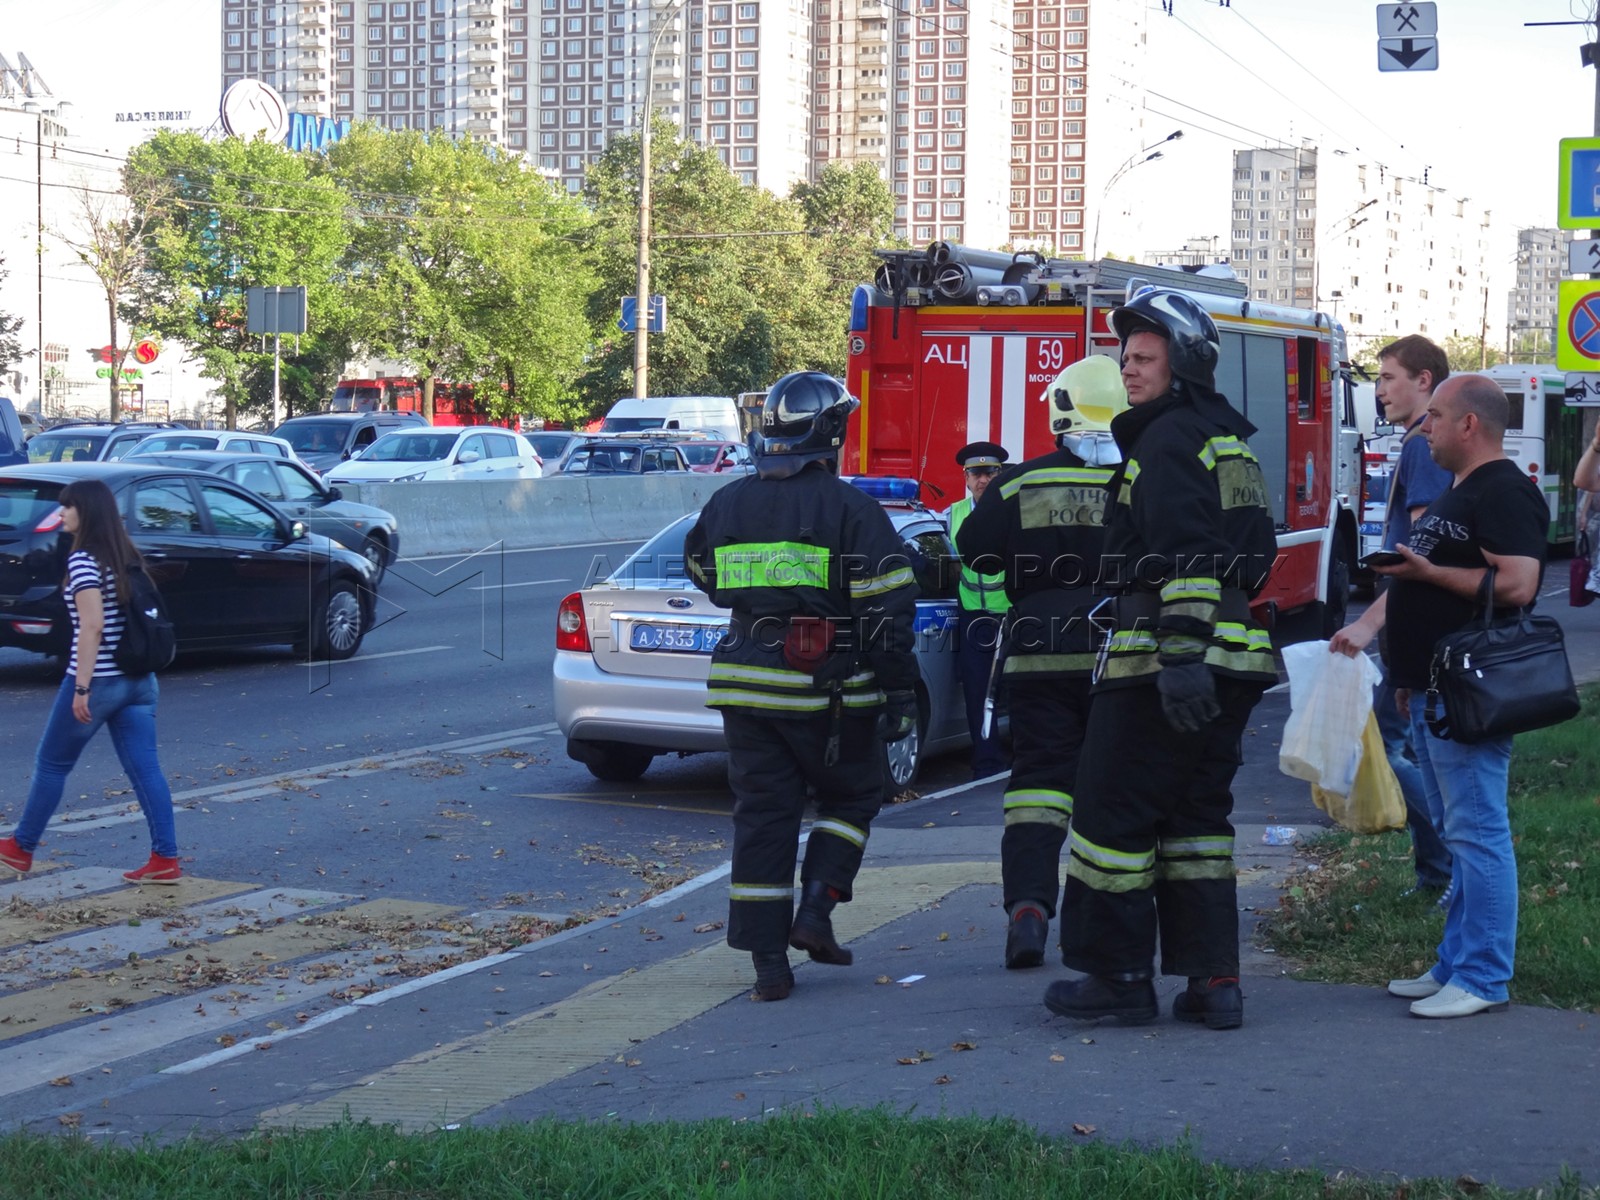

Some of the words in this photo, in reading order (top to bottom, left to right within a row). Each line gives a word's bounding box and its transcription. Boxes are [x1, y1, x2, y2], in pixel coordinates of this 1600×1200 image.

[924, 344, 967, 369] АЦ
[1038, 340, 1063, 369] 59
[1029, 374, 1056, 382] МОСК
[1049, 506, 1103, 525] РОСС
